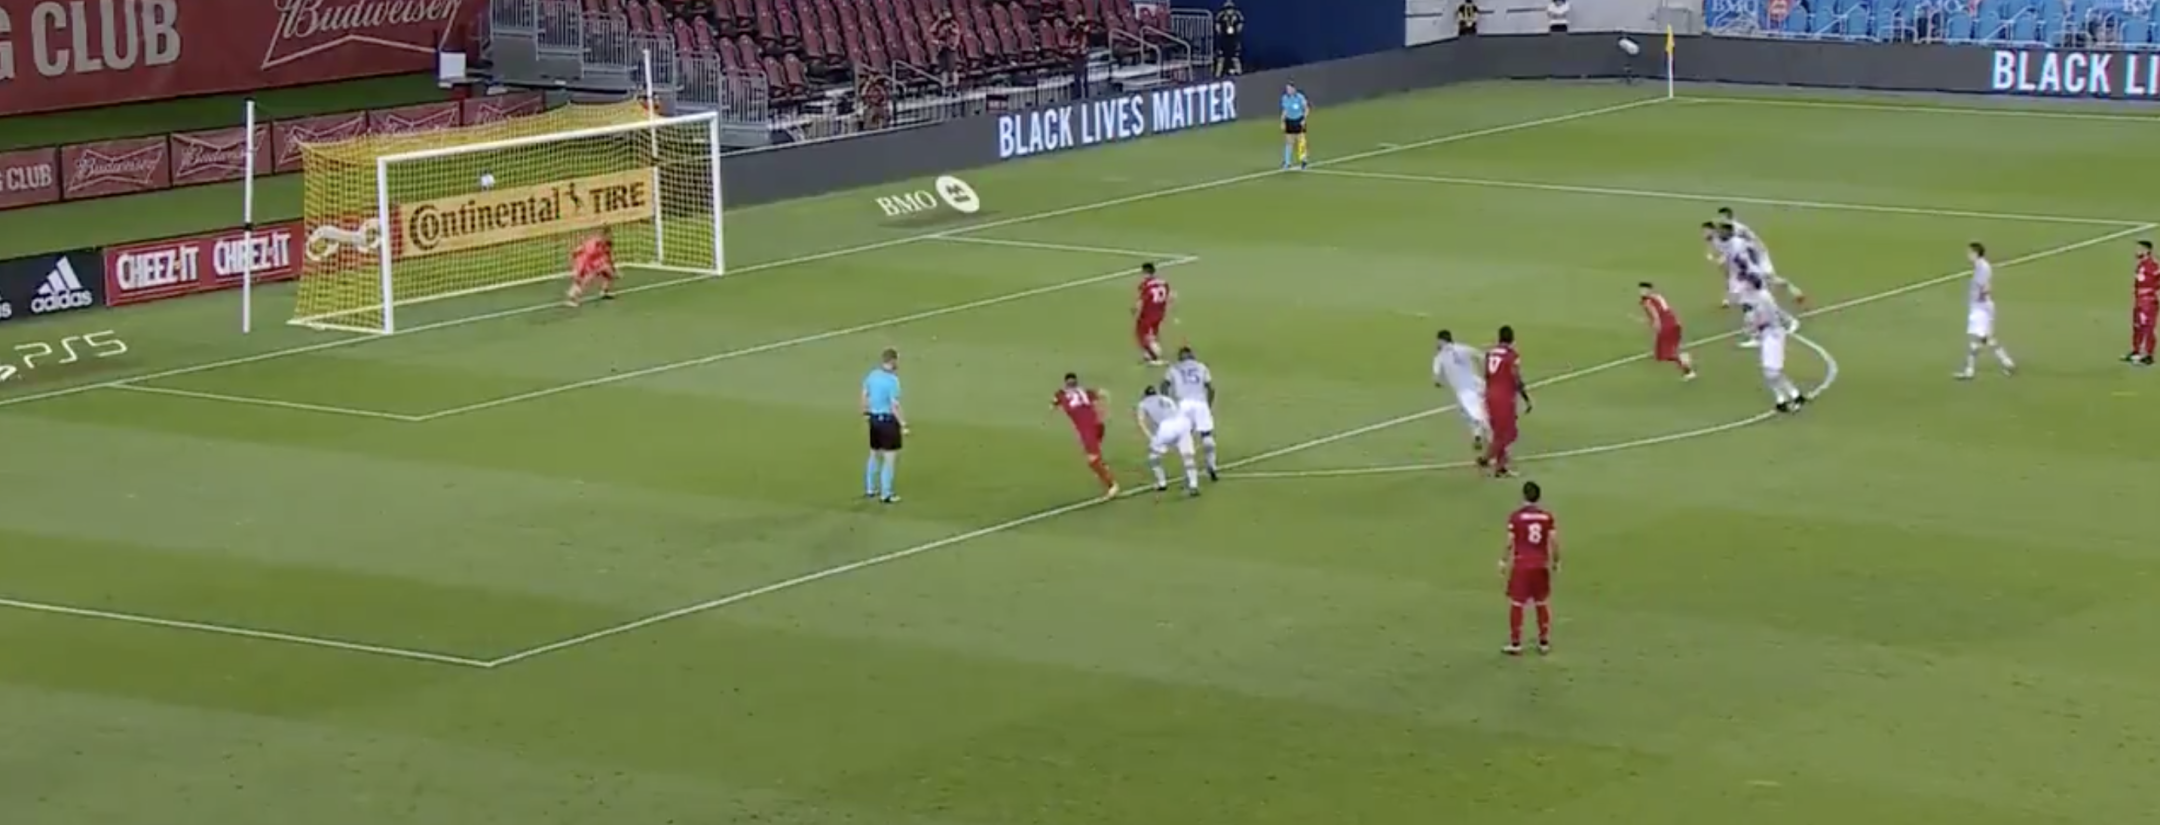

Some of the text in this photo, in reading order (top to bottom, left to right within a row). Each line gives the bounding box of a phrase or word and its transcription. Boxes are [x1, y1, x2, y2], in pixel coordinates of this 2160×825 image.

[31, 0, 181, 77] CLUB
[1992, 50, 2113, 94] BLACK
[999, 81, 1236, 158] BLACK LIVES MATTER
[6, 163, 52, 191] CLUB
[408, 181, 646, 251] Continental TIRE
[875, 189, 937, 217] BMO
[115, 245, 199, 291] CHEEZ-IT
[31, 287, 92, 313] adidas
[13, 330, 128, 369] PS5
[1528, 522, 1542, 544] 8
